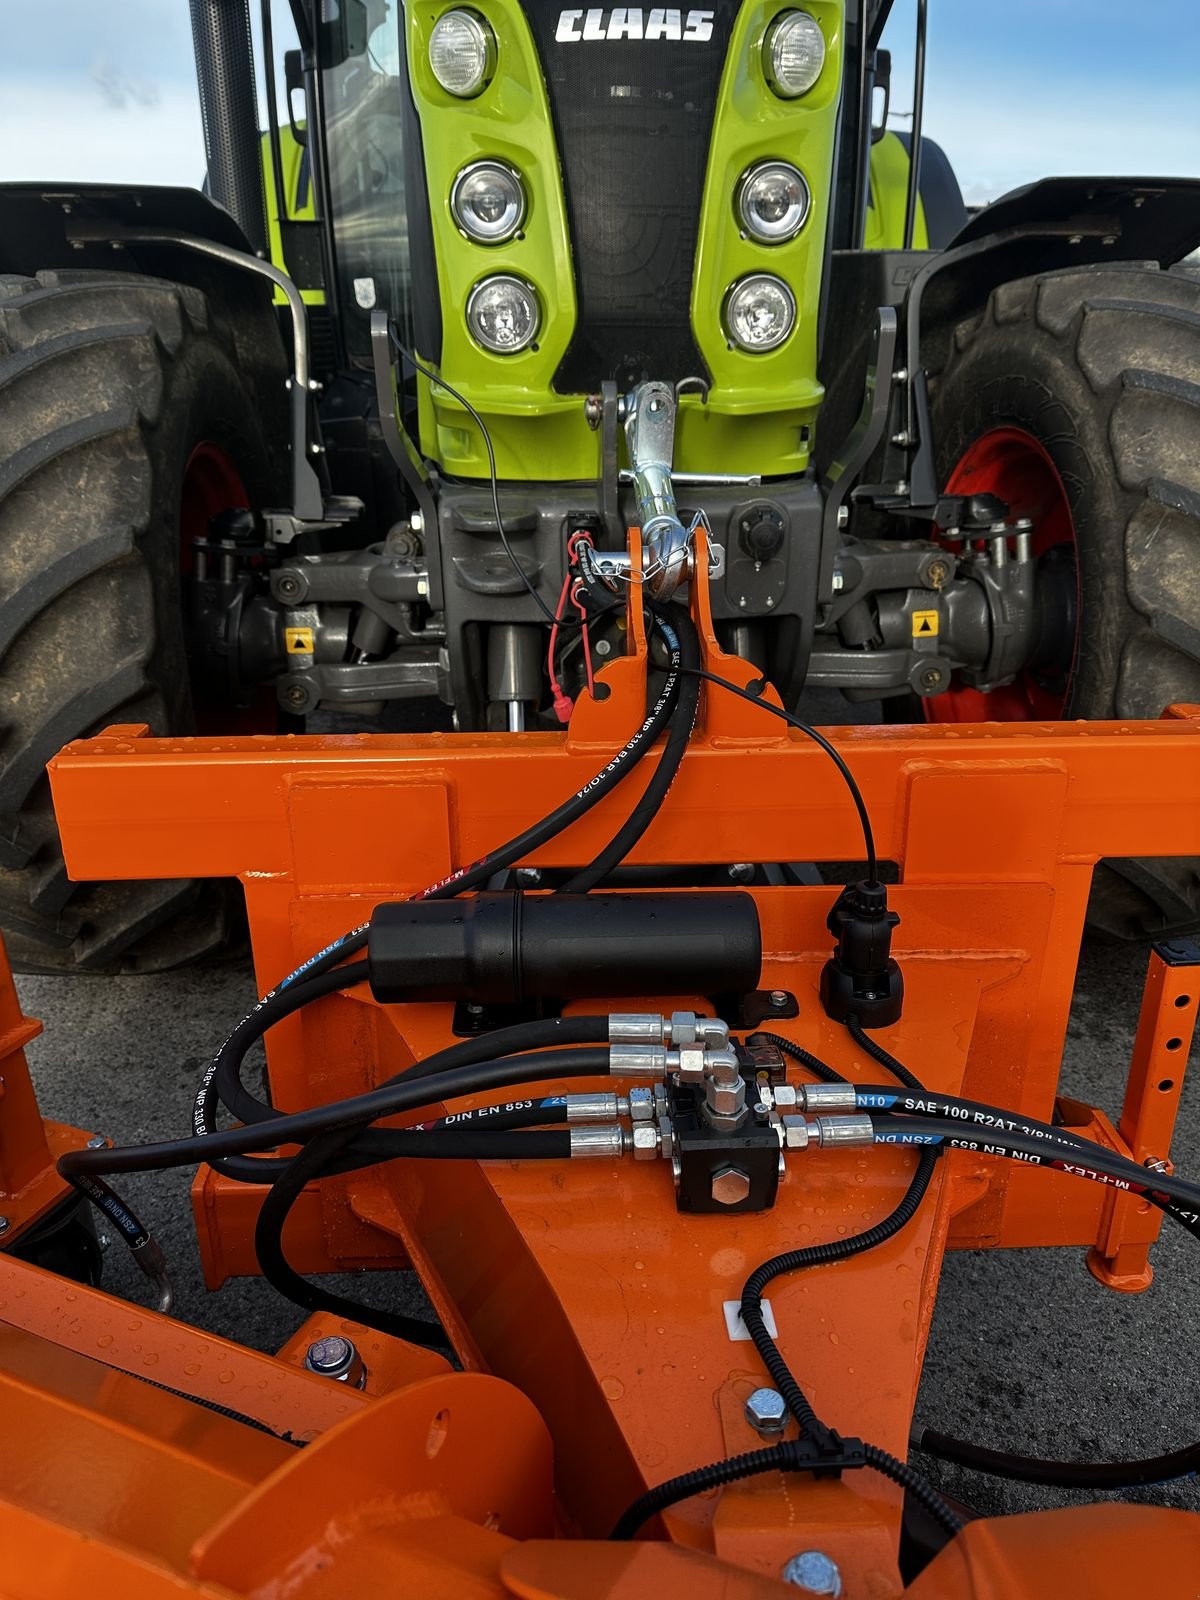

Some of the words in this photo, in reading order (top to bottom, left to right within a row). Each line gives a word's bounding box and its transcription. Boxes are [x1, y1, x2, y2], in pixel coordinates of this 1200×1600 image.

[555, 8, 715, 43] CLAAS
[662, 677, 676, 698] R2AT
[642, 716, 656, 731] WP
[626, 733, 643, 749] 330
[606, 750, 628, 771] BAR
[423, 869, 464, 896] M-FLEX
[287, 957, 316, 981] DN10
[195, 1088, 207, 1106] WP
[194, 1108, 205, 1126] 330
[445, 1113, 473, 1125] DIN
[478, 1105, 500, 1117] EN
[505, 1100, 533, 1111] 853
[904, 1098, 937, 1113] SAE
[942, 1104, 969, 1120] 100
[974, 1111, 1017, 1131] R2AT
[901, 1135, 933, 1145] 2SN
[950, 1139, 978, 1150] 853
[983, 1141, 1007, 1156] EN
[1012, 1150, 1041, 1165] DIN
[1063, 1163, 1130, 1191] M-FLEX
